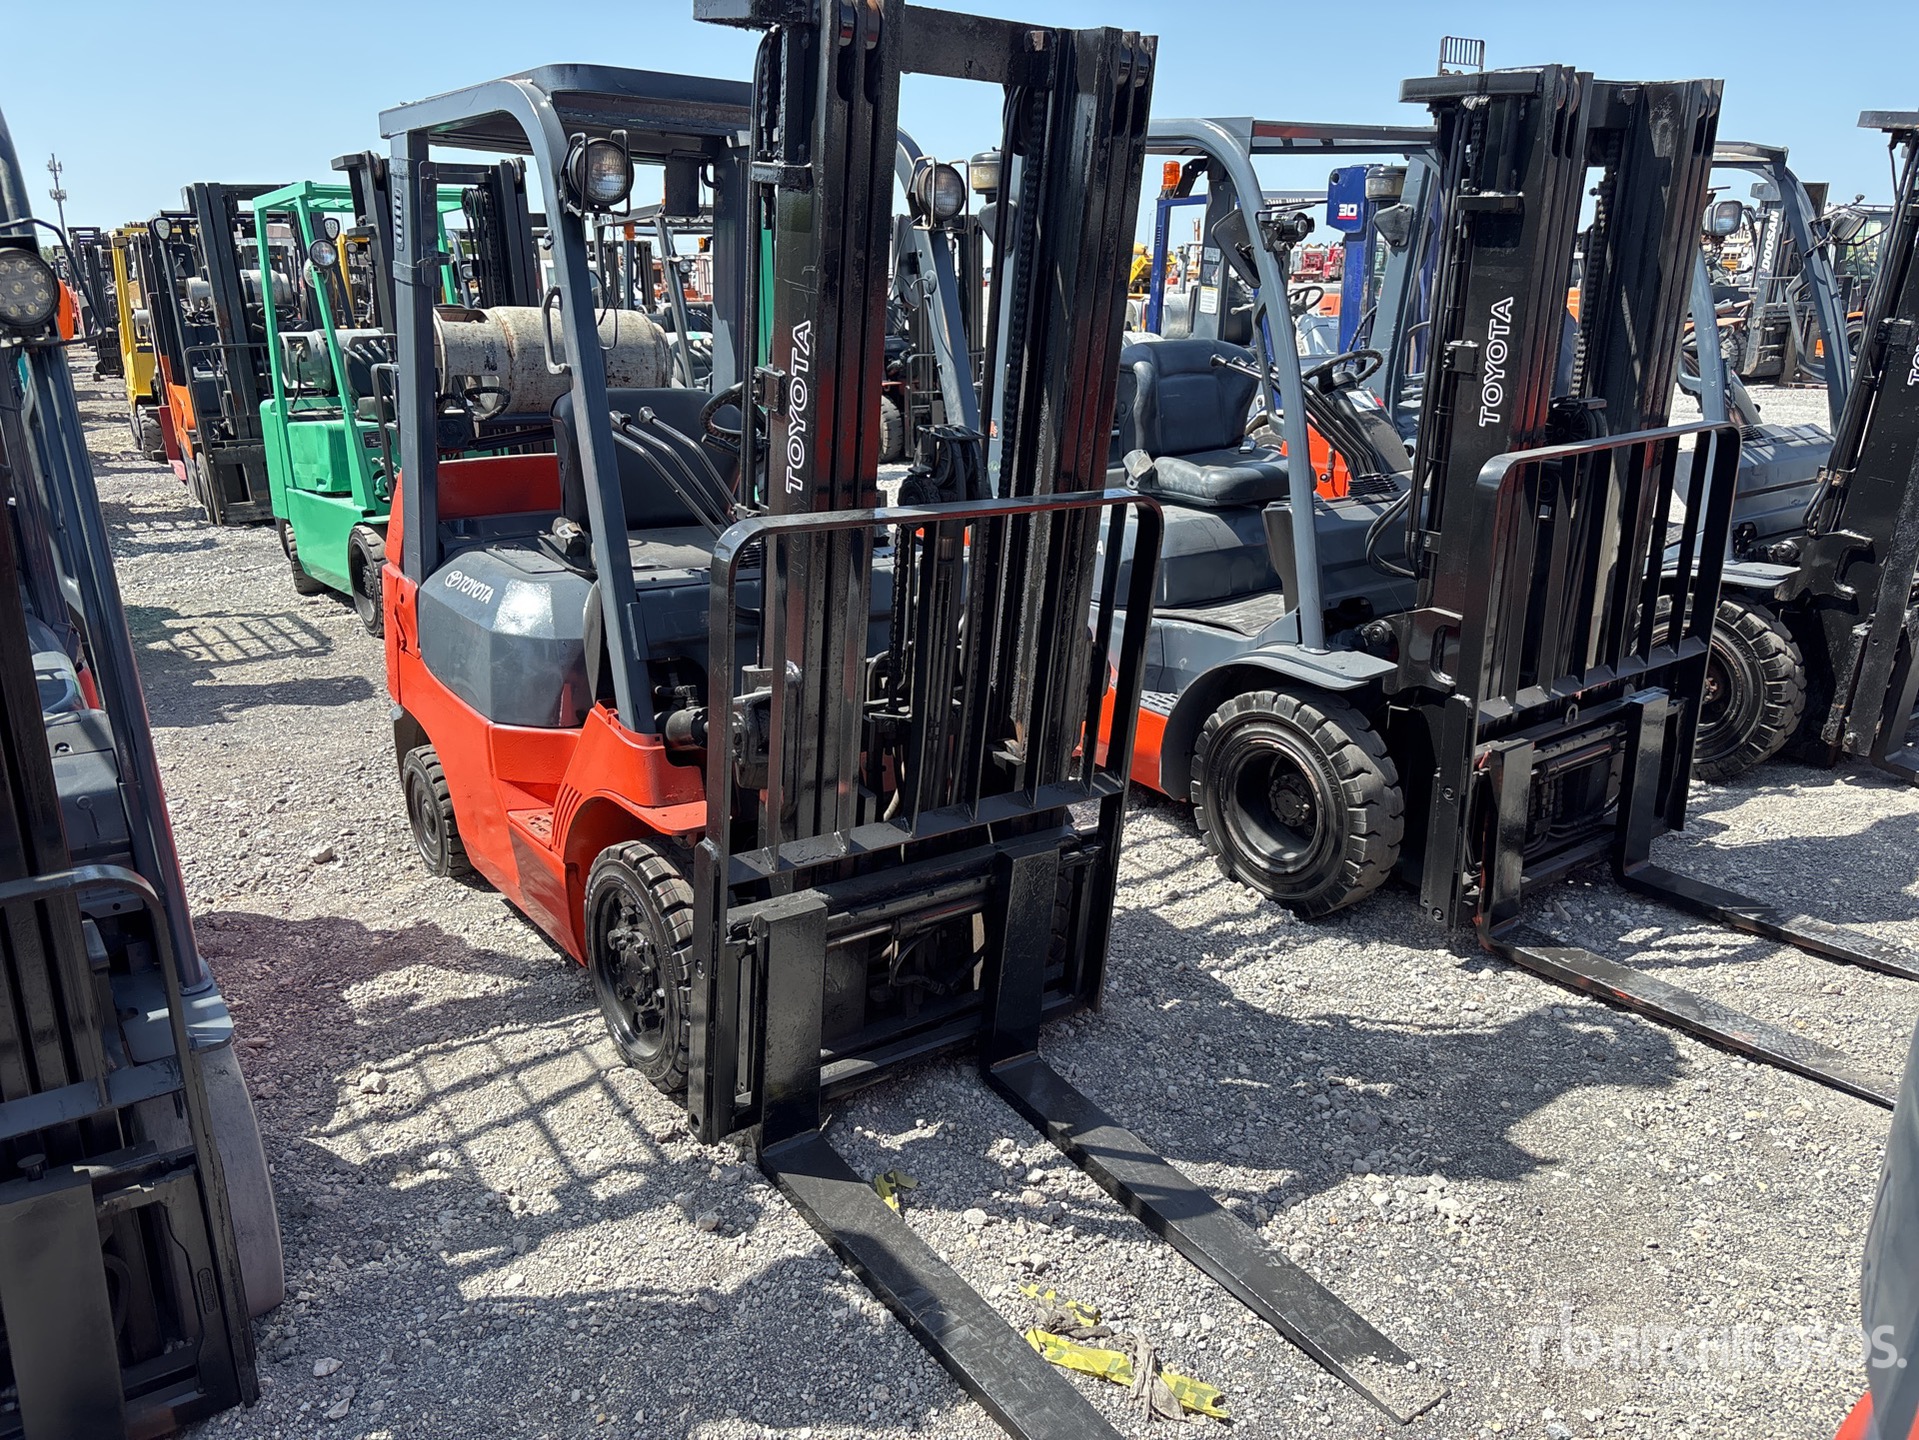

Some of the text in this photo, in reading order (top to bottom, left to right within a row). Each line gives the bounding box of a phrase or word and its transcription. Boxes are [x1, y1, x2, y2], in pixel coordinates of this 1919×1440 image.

[1338, 203, 1358, 217] 30
[1761, 210, 1779, 272] DOOSAN
[1478, 296, 1514, 427] TOYOTA
[786, 319, 812, 494] TOYOTA
[456, 575, 495, 605] TOYOTA
